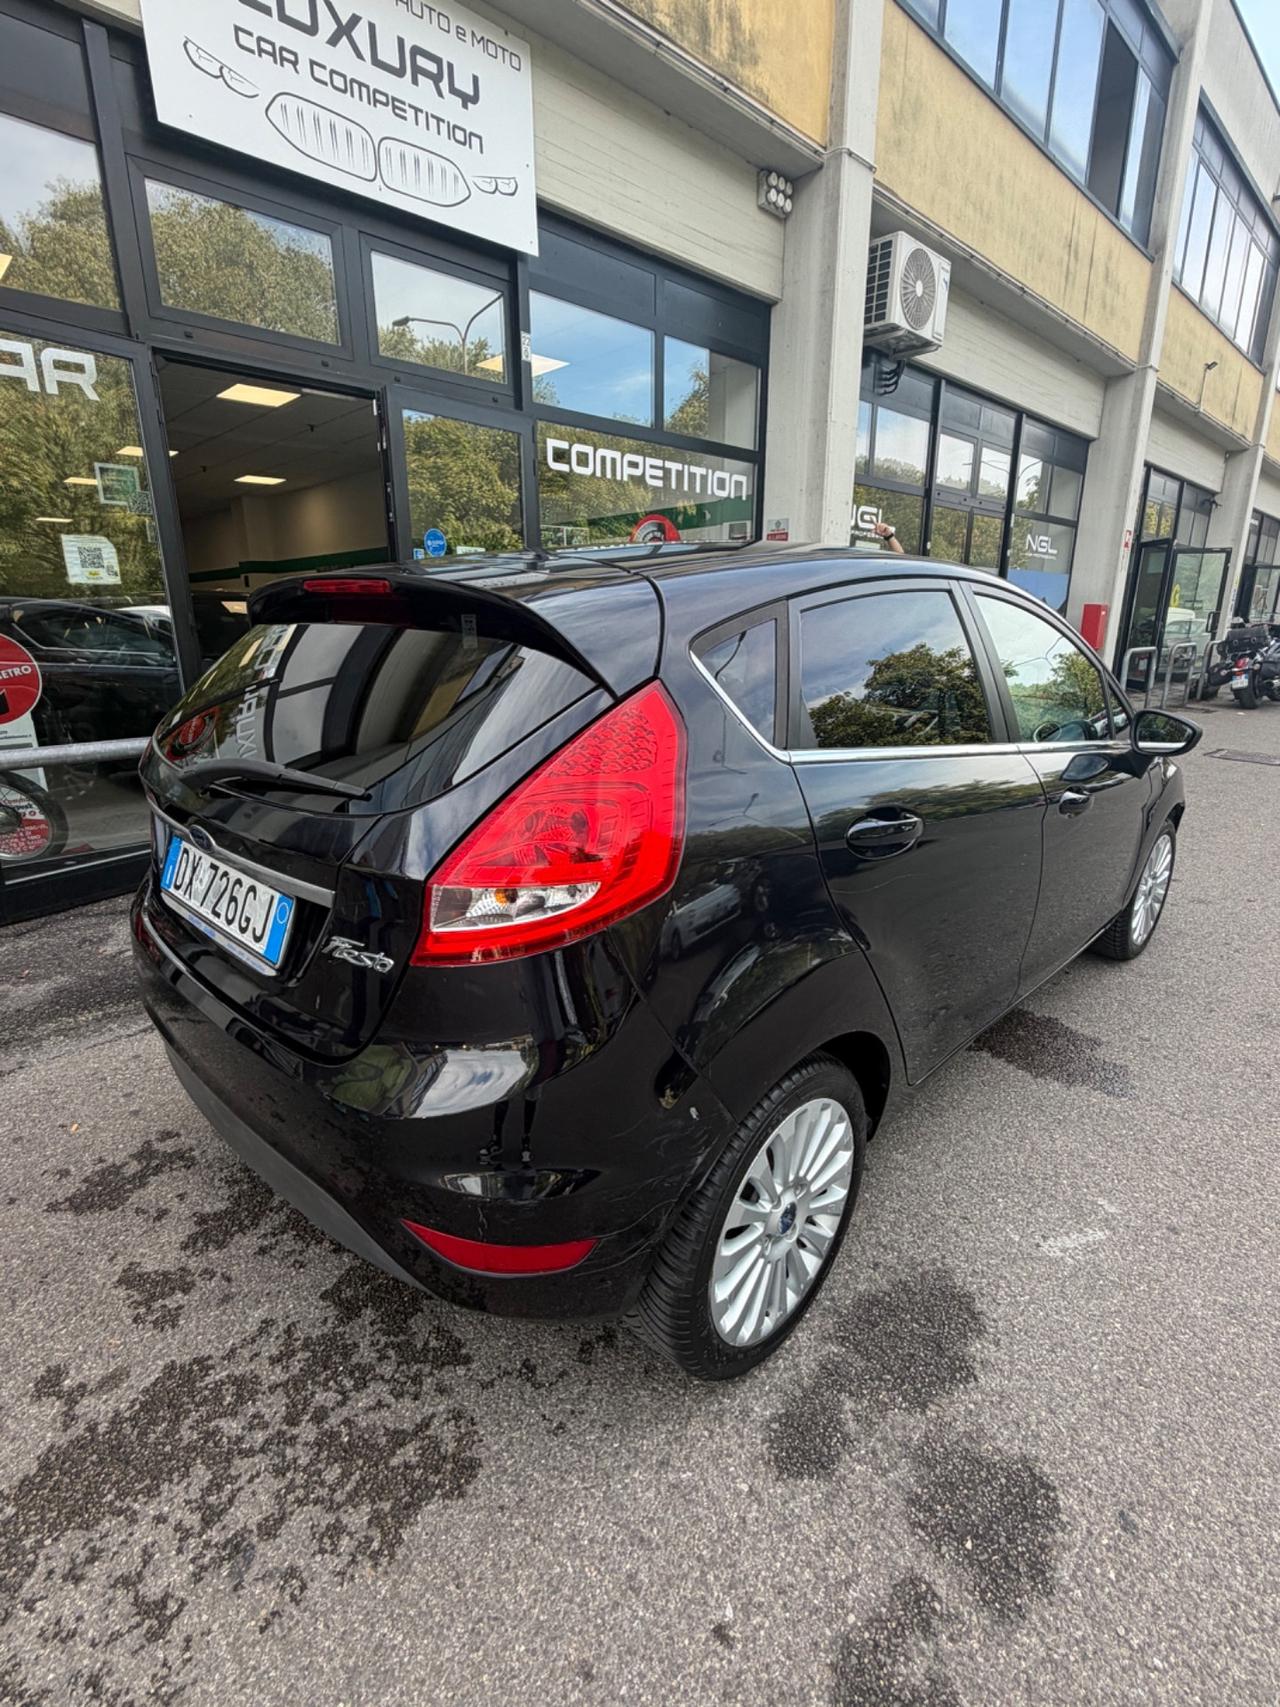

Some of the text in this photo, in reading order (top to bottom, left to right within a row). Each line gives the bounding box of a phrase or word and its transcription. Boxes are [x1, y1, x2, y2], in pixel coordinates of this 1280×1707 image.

[456, 25, 467, 43] e
[471, 30, 521, 72] MOTO
[233, 23, 484, 154] CAR COMPETITION
[546, 438, 748, 501] COMPETITION
[1026, 533, 1058, 555] NGL
[173, 847, 275, 944] DX 726GJ
[321, 935, 395, 973] Fiesta
